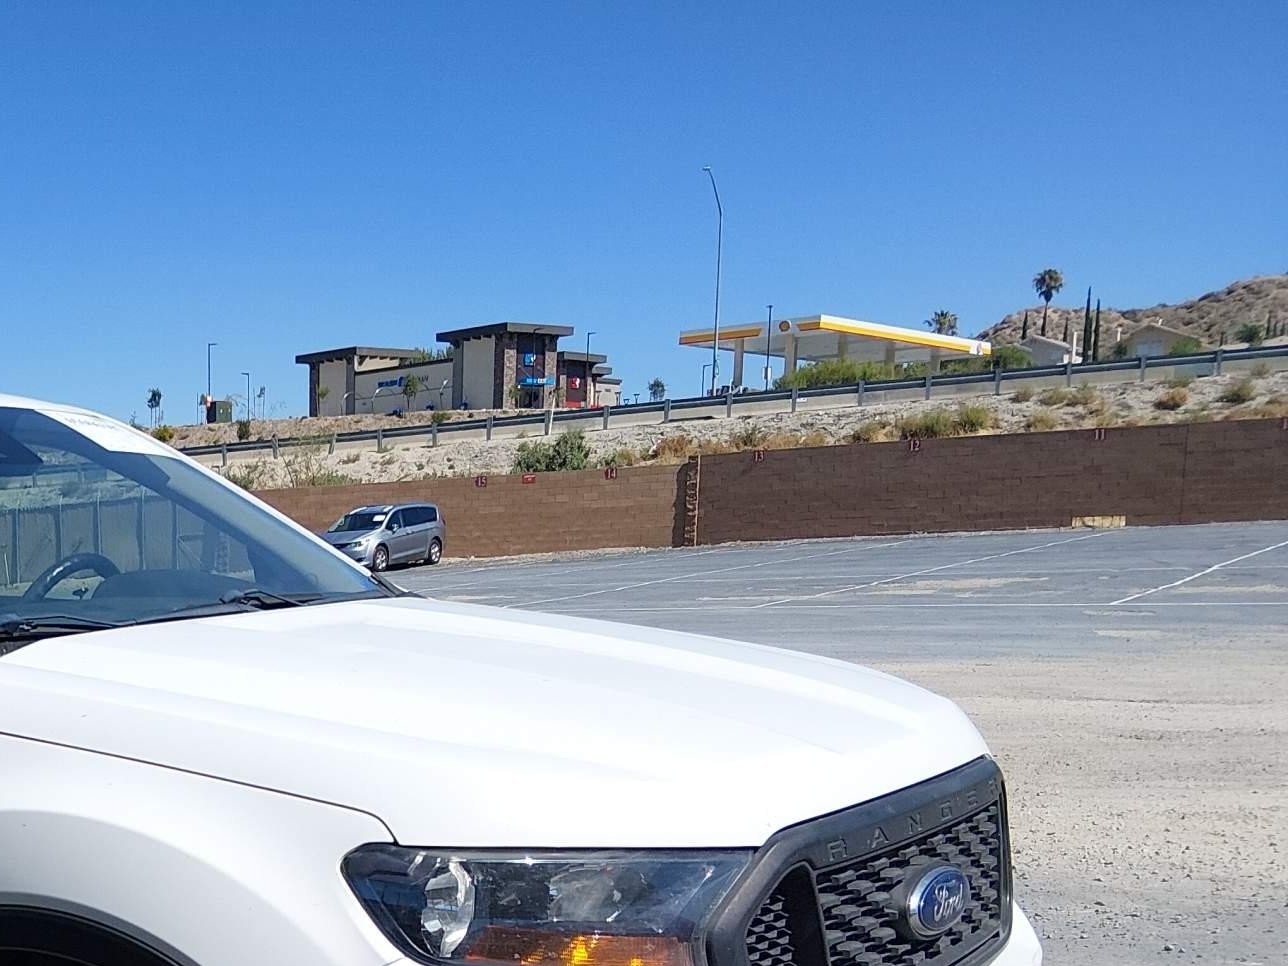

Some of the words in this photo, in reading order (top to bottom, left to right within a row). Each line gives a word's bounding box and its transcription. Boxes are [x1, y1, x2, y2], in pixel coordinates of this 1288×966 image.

[910, 439, 920, 451] 12
[478, 476, 487, 487] 15
[934, 879, 964, 922] Ford
